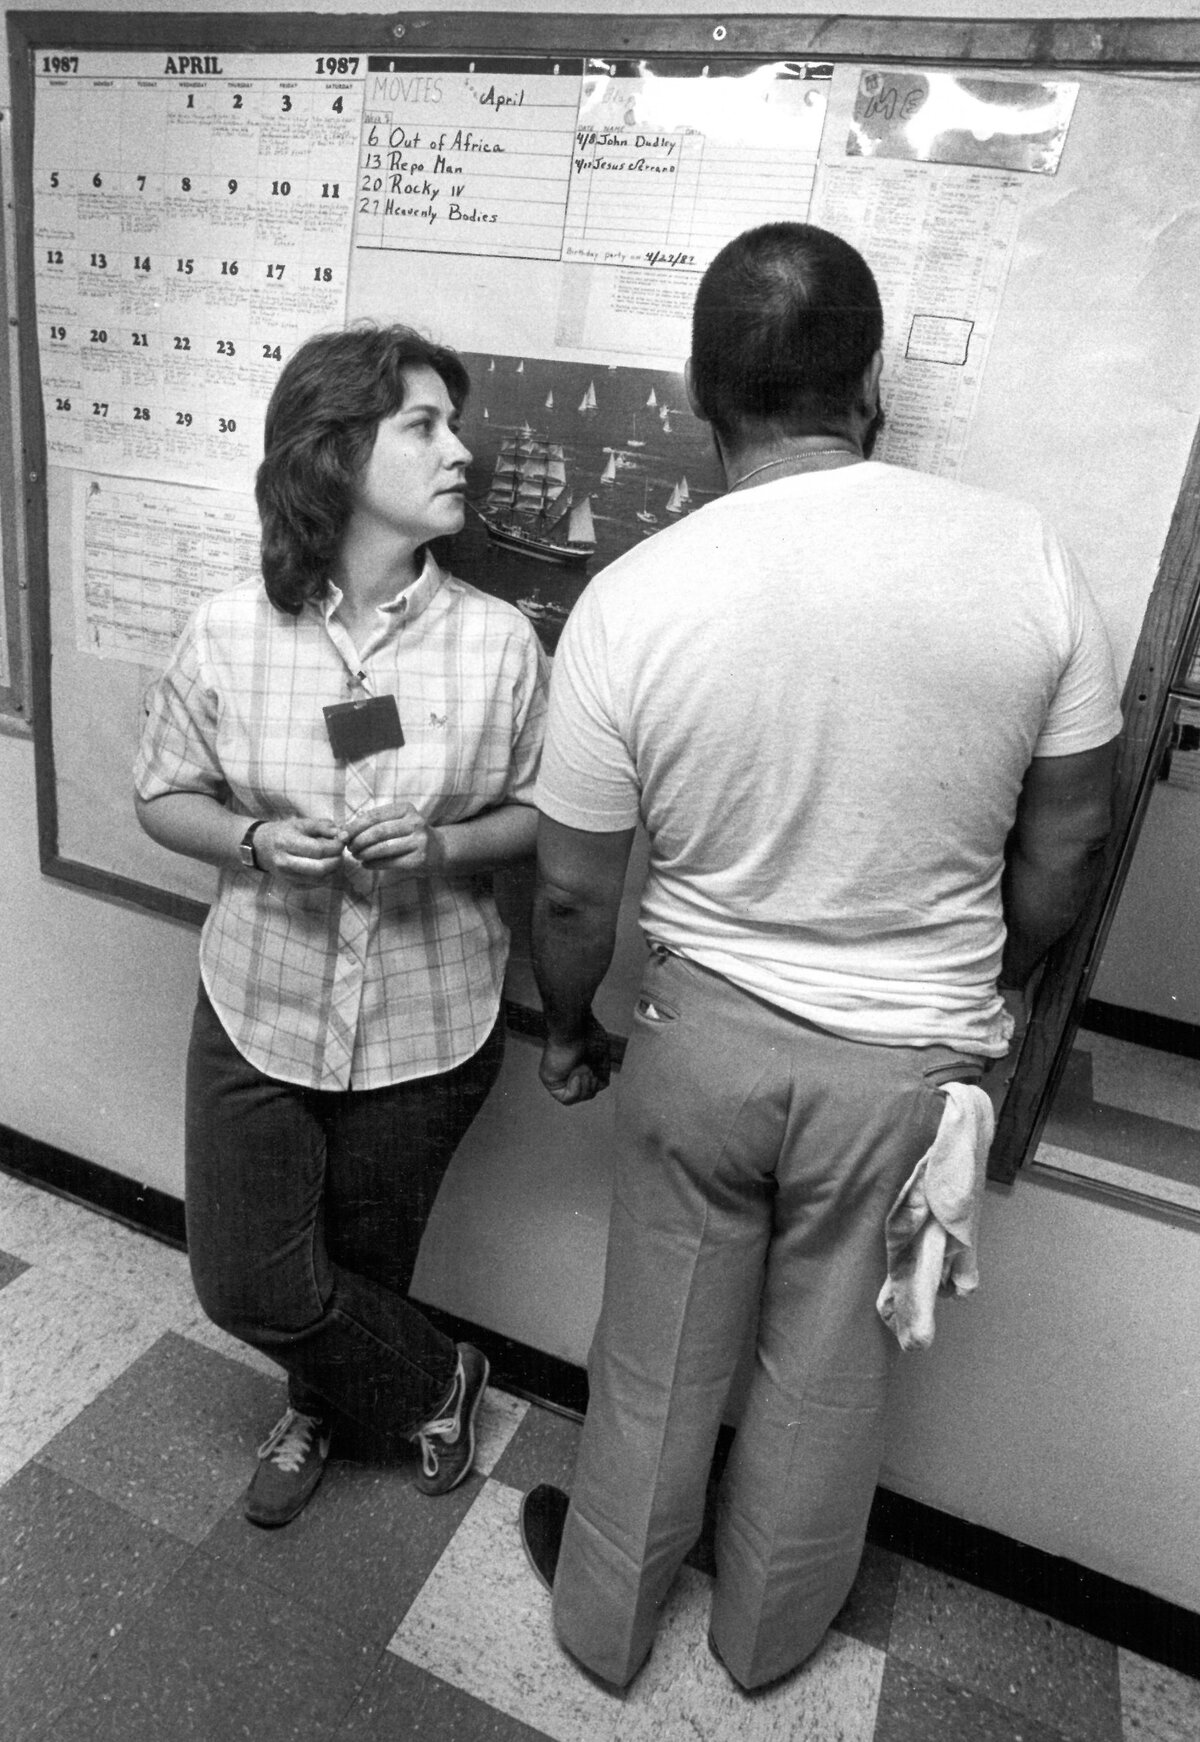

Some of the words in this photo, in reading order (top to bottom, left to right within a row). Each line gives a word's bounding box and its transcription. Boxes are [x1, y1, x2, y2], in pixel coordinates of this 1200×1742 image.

[43, 57, 78, 73] 1987
[165, 56, 222, 74] APRIL
[316, 57, 359, 75] 1987
[186, 93, 194, 109] 1
[232, 93, 244, 109] 2
[281, 94, 293, 112] 3
[331, 95, 344, 114] 4
[371, 76, 444, 104] MOVIES
[479, 84, 525, 112] April
[367, 125, 379, 147] 6
[389, 127, 421, 149] Out
[430, 133, 447, 151] of
[450, 129, 506, 153] Africa
[576, 132, 596, 151] 4/8
[597, 134, 628, 146] John
[635, 135, 676, 156] Dudley
[365, 153, 382, 169] 13
[387, 151, 424, 176] Repo
[433, 154, 463, 174] Man
[593, 157, 625, 170] Jesus
[50, 171, 59, 189] 5
[92, 172, 103, 188] 6
[136, 175, 147, 192] 7
[181, 177, 192, 192] 8
[227, 178, 238, 195] 9
[271, 180, 291, 197] 10
[321, 183, 340, 199] 11
[361, 175, 383, 192] 20
[389, 173, 440, 201] Rocky
[384, 199, 437, 225] Heavenly
[448, 203, 498, 224] Bodies
[47, 250, 64, 265] 12
[90, 253, 108, 269] 13
[134, 255, 152, 273] 14
[176, 258, 194, 275] 15
[221, 260, 239, 276] 16
[266, 263, 286, 281] 17
[313, 266, 333, 283] 18
[50, 326, 67, 341] 19
[90, 329, 108, 344] 20
[131, 332, 149, 347] 21
[173, 336, 191, 351] 22
[216, 340, 236, 357] 23
[262, 344, 282, 362] 24
[55, 398, 72, 412] 26
[92, 402, 109, 418] 27
[133, 406, 151, 421] 28
[175, 411, 193, 427] 29
[218, 417, 237, 433] 30
